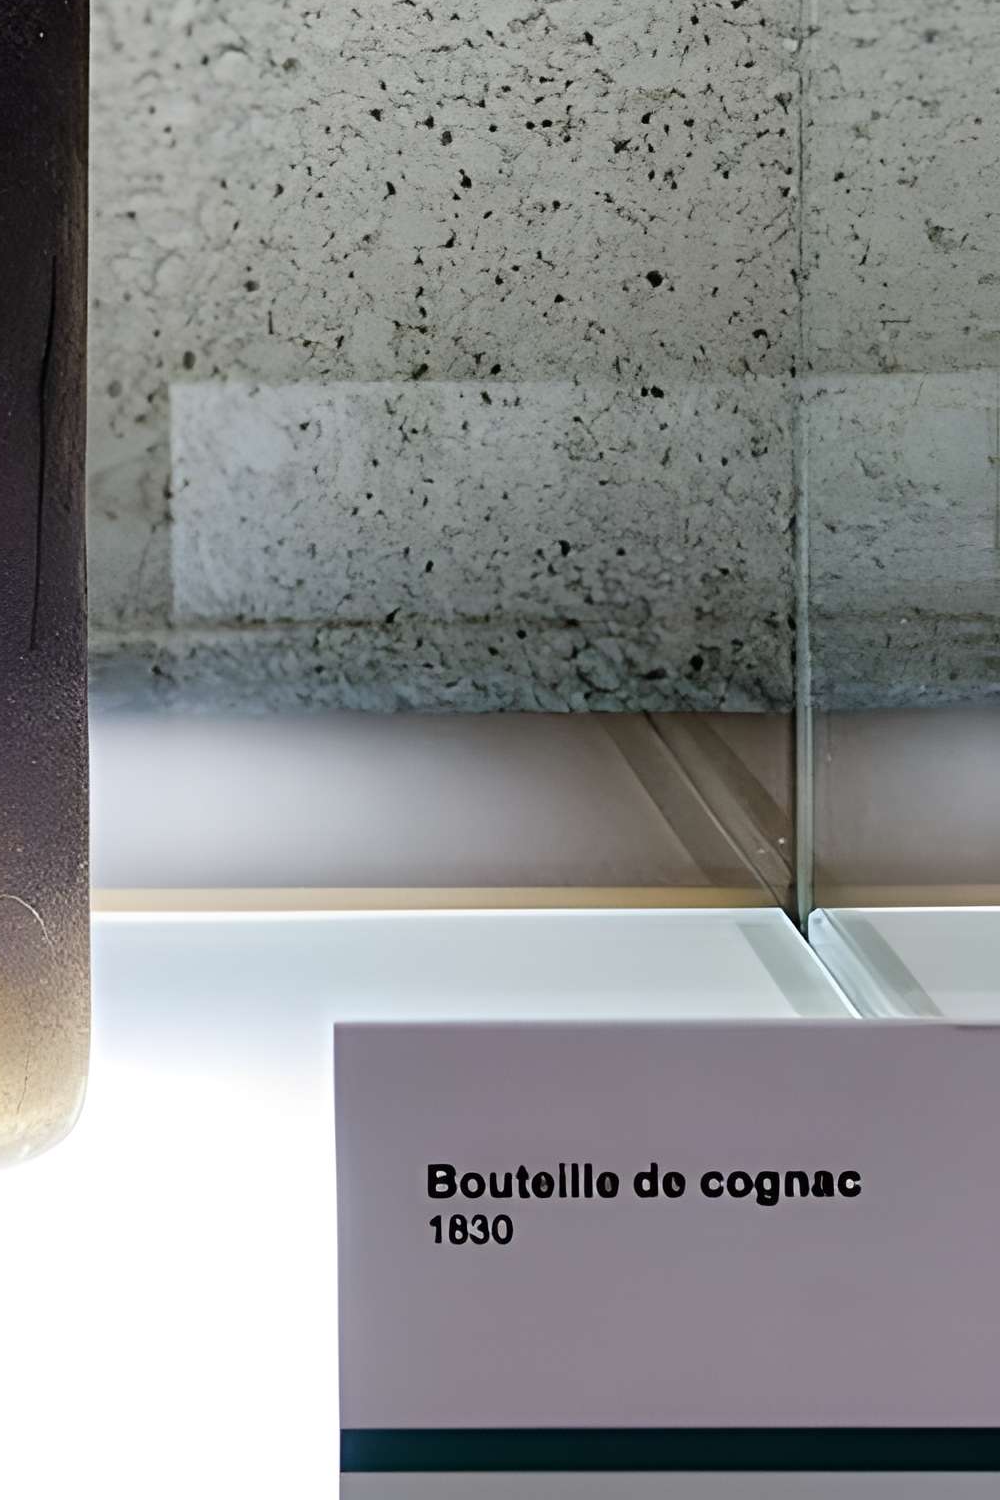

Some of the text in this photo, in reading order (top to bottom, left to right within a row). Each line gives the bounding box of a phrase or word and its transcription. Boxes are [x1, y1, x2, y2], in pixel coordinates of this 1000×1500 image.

[427, 1162, 862, 1206] Bouteille de cognac
[429, 1214, 513, 1245] 1830
